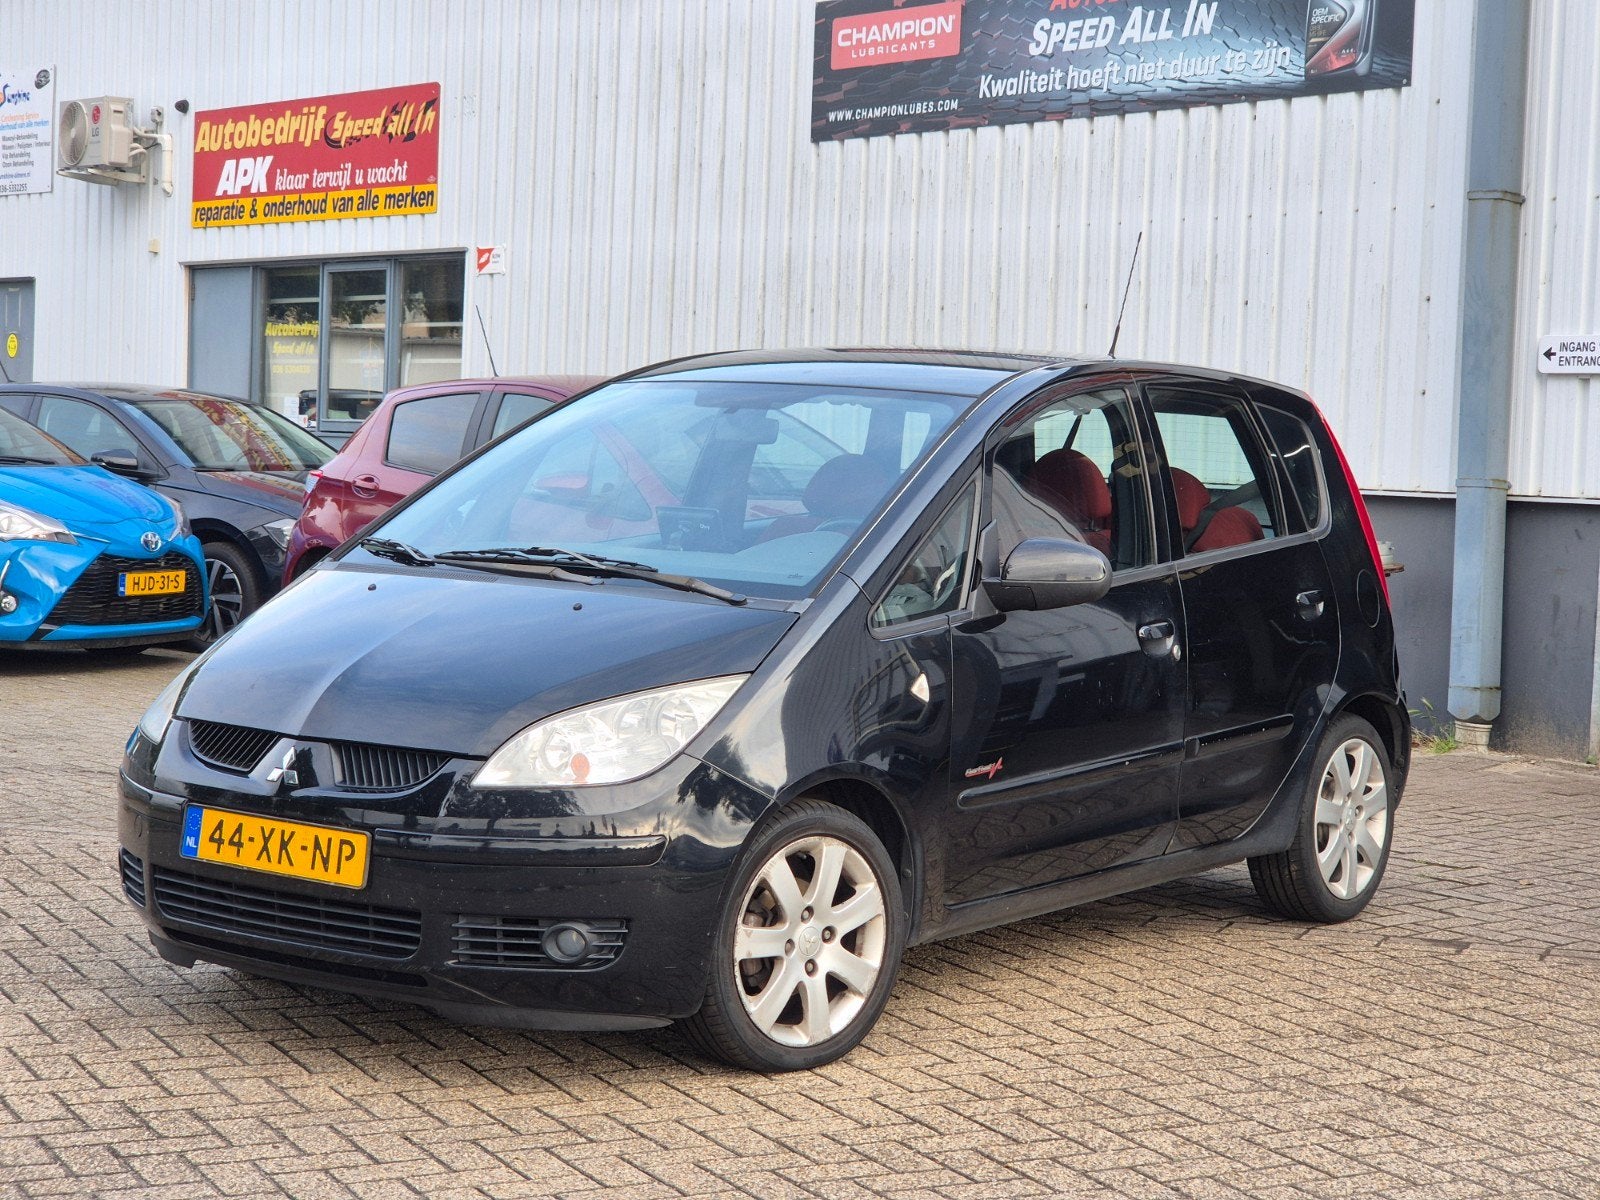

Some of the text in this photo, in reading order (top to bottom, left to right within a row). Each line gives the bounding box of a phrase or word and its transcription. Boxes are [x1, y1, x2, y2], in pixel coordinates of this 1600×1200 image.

[1310, 14, 1340, 25] SPECIFIC
[1312, 7, 1329, 17] OEM
[837, 15, 953, 48] CHAMPION
[1029, 0, 1218, 56] SPEED ALL IN
[851, 39, 936, 59] LUBRICANTS
[979, 41, 1292, 99] Kwaliteit hoeft niet duur te zijn
[828, 99, 959, 122] WWW.CHAMPIONLUBES.COM
[91, 127, 100, 137] LG
[195, 105, 327, 152] Autobedrijf
[331, 105, 388, 148] Speed
[215, 155, 408, 197] APK klaar terwijl u wacht
[195, 186, 434, 226] reparatie & onderhoud van alle merken
[1559, 341, 1596, 352] INGANG
[132, 574, 180, 592] HJD-31-S
[185, 835, 198, 848] NL
[208, 818, 356, 875] 44-XK-NP
